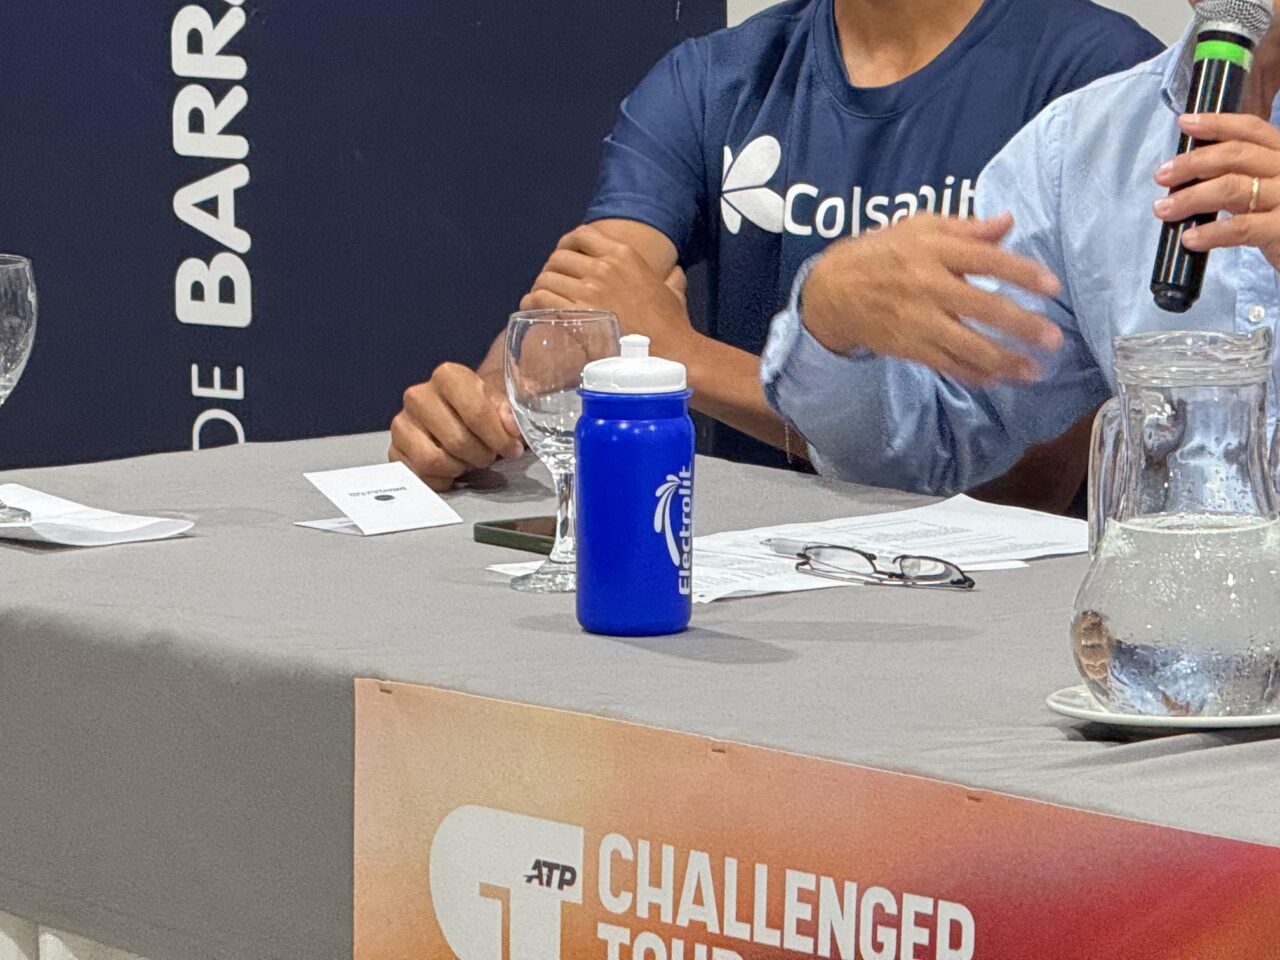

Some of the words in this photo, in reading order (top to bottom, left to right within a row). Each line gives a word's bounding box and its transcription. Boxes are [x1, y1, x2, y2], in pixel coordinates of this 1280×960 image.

[191, 362, 246, 452] DE
[678, 462, 692, 596] Electrolit
[523, 858, 577, 891] ATP
